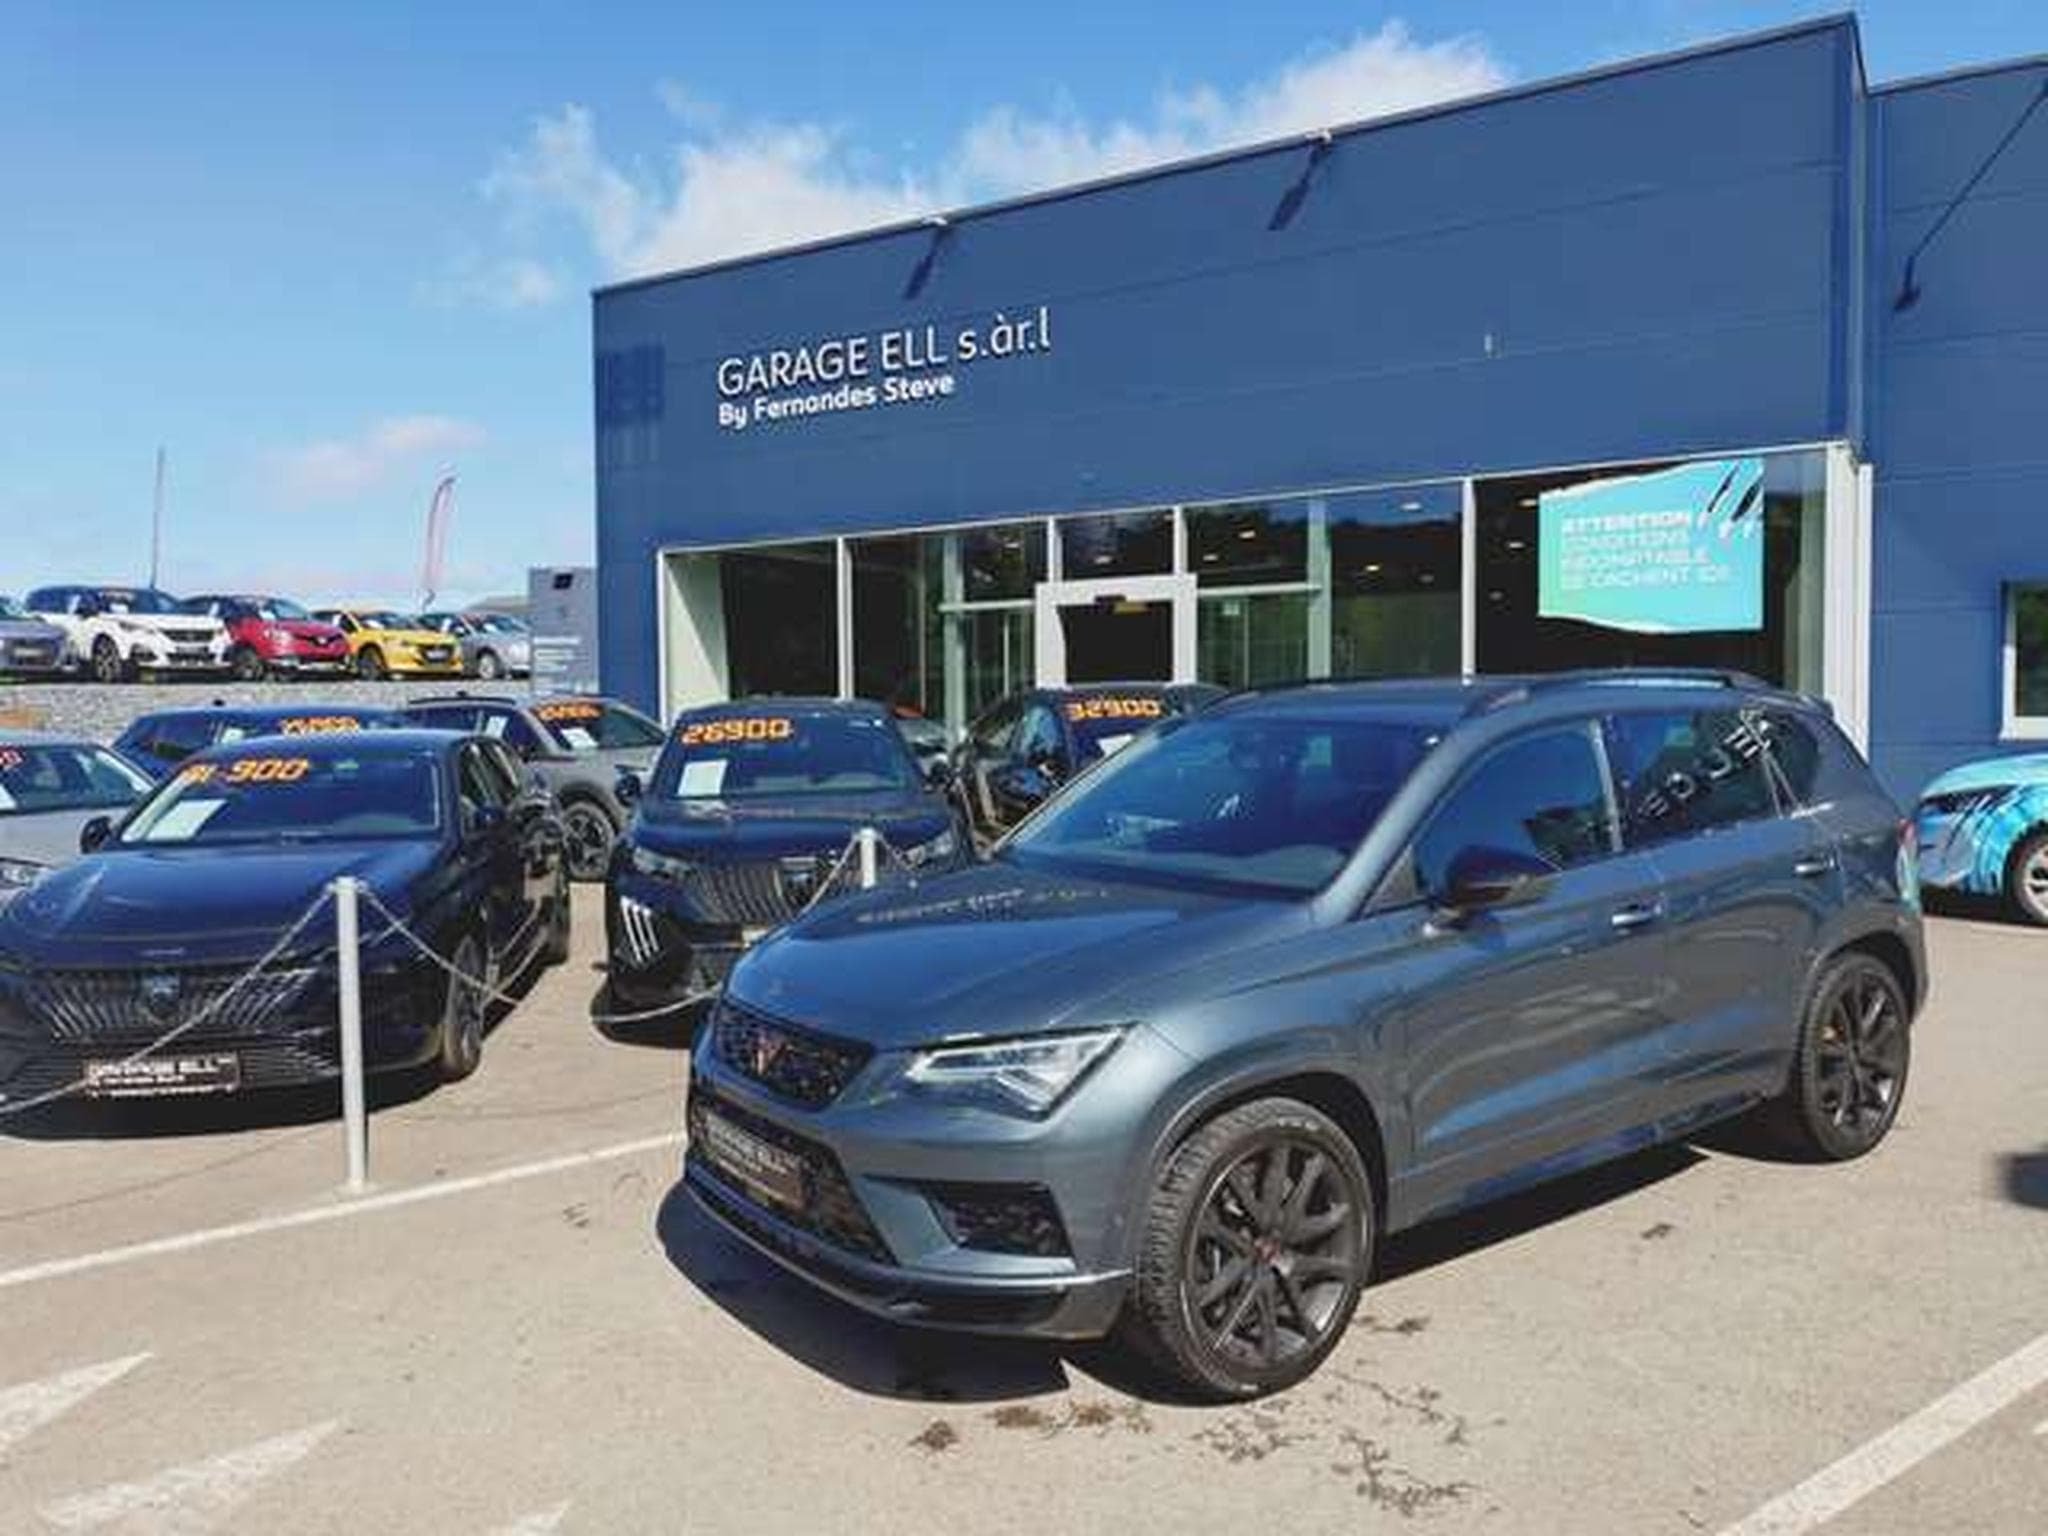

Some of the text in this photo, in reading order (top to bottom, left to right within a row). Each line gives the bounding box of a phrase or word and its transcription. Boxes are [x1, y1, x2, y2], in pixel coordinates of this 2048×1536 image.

[718, 338, 869, 396] GARAGE
[881, 326, 948, 370] ELL
[718, 374, 955, 430] By Fernandes Steve
